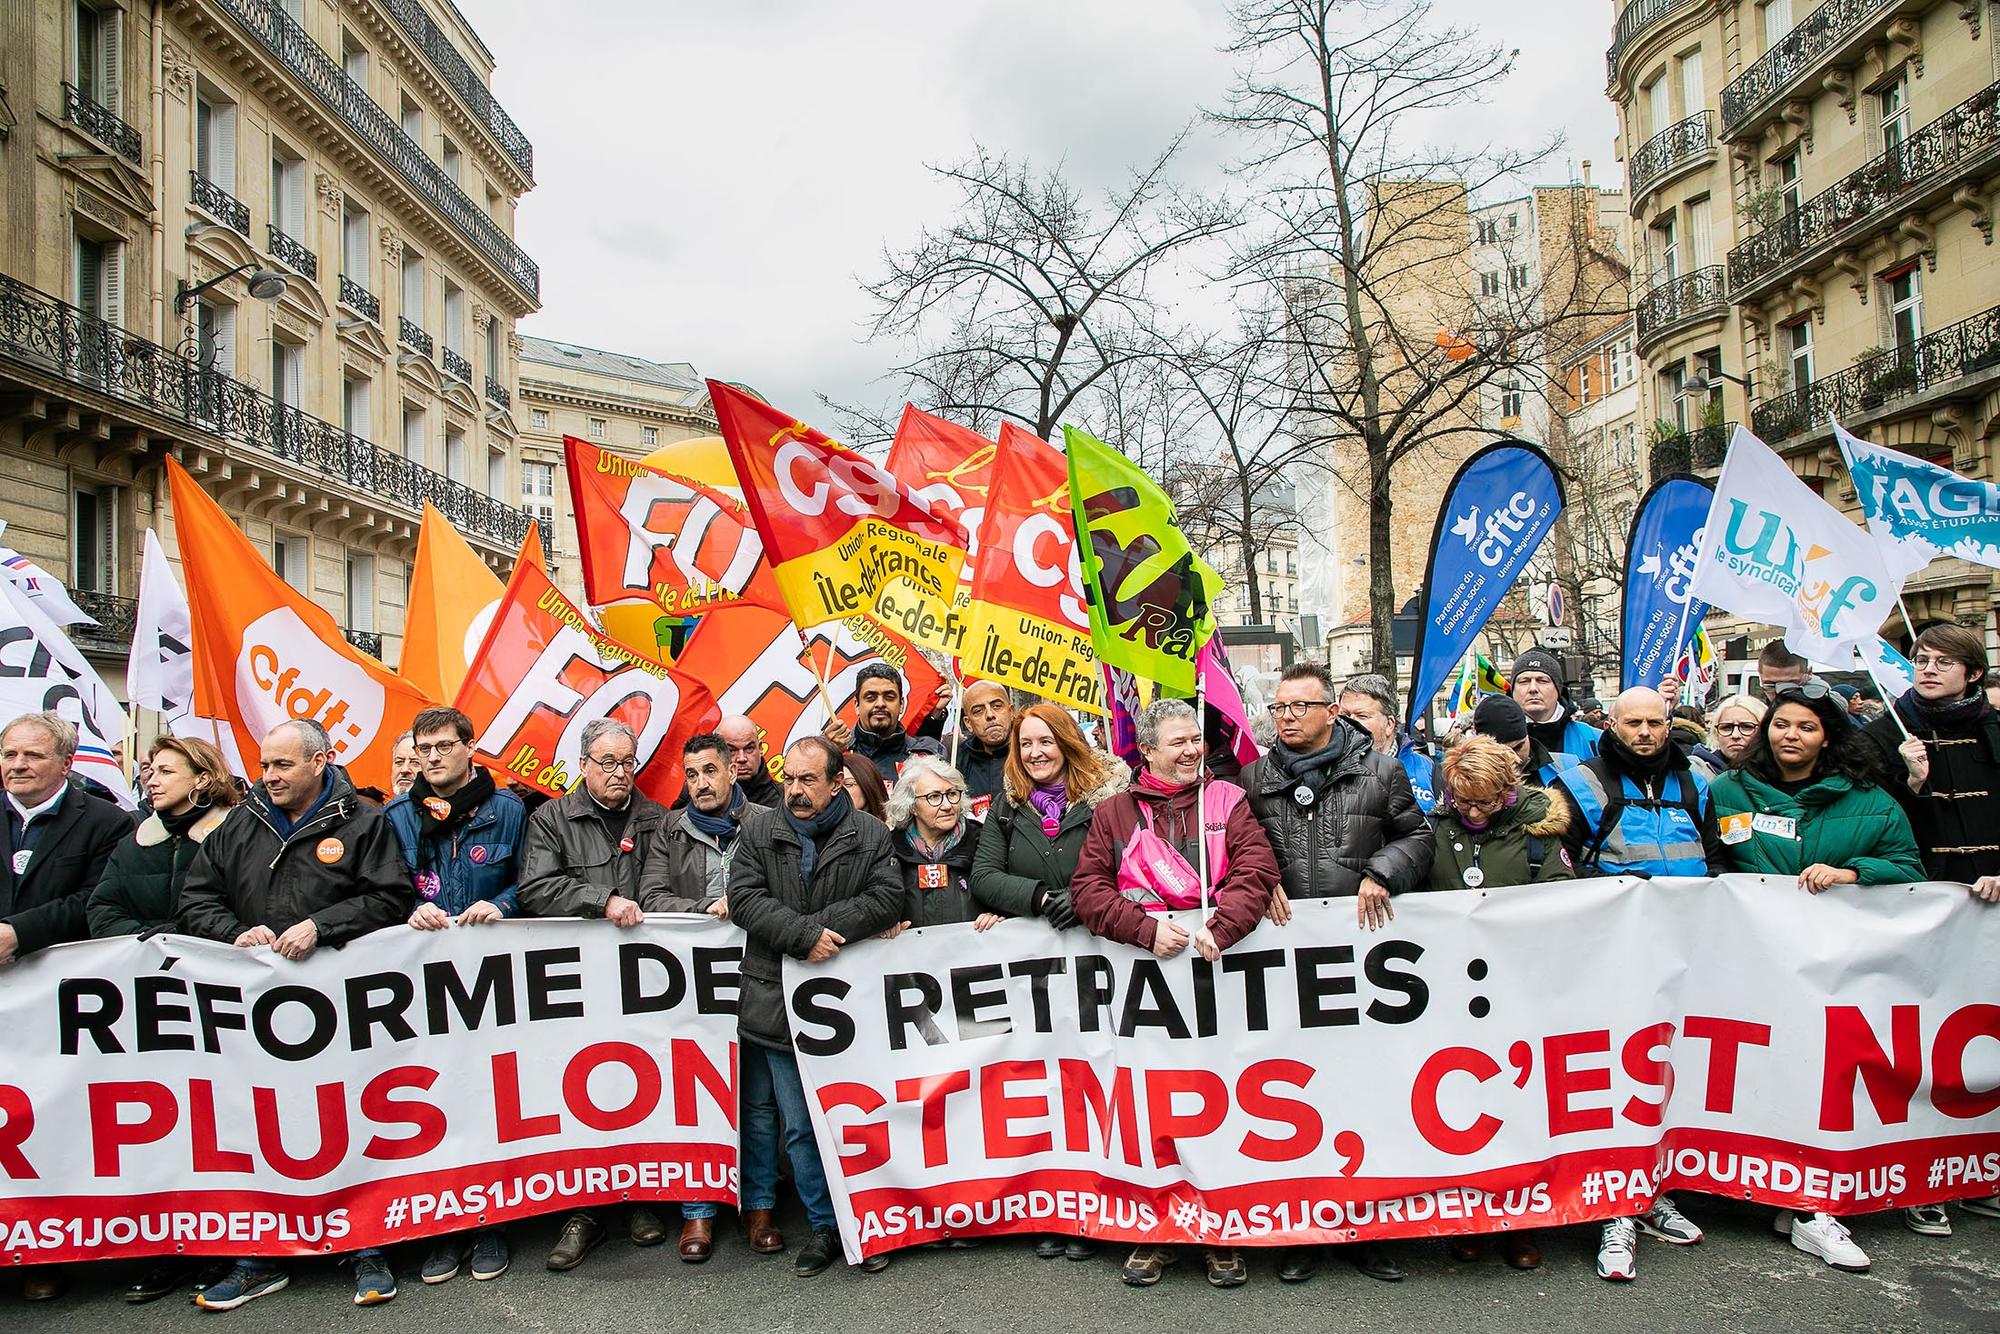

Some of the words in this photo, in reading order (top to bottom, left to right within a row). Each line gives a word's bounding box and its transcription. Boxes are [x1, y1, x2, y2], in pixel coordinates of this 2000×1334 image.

[866, 522, 949, 564] Régionale
[1477, 491, 1536, 567] cftc
[1497, 556, 1516, 579] Union
[1514, 520, 1541, 557] Régionale
[1539, 502, 1552, 519] IDF
[1932, 515, 1999, 530] ÉTUDIAN
[812, 544, 943, 616] Île-de-France
[1434, 583, 1467, 626] Partenaire
[1463, 570, 1475, 585] du
[1714, 545, 1726, 564] le
[1728, 556, 1802, 599] syndicat
[536, 586, 585, 633] Union
[1442, 597, 1471, 636] dialogue
[1467, 574, 1487, 601] social
[980, 624, 1103, 706] Île-de-Fran
[1638, 638, 1665, 677] dialogue
[1660, 611, 1679, 641] social
[476, 622, 681, 790] FO
[537, 760, 568, 793] de
[58, 946, 585, 1062] RÉFORME
[884, 940, 1430, 1051] RETRAITES
[88, 1065, 447, 1181] PLUS
[1175, 1182, 1552, 1240] #PAS1JOURDEPLUS
